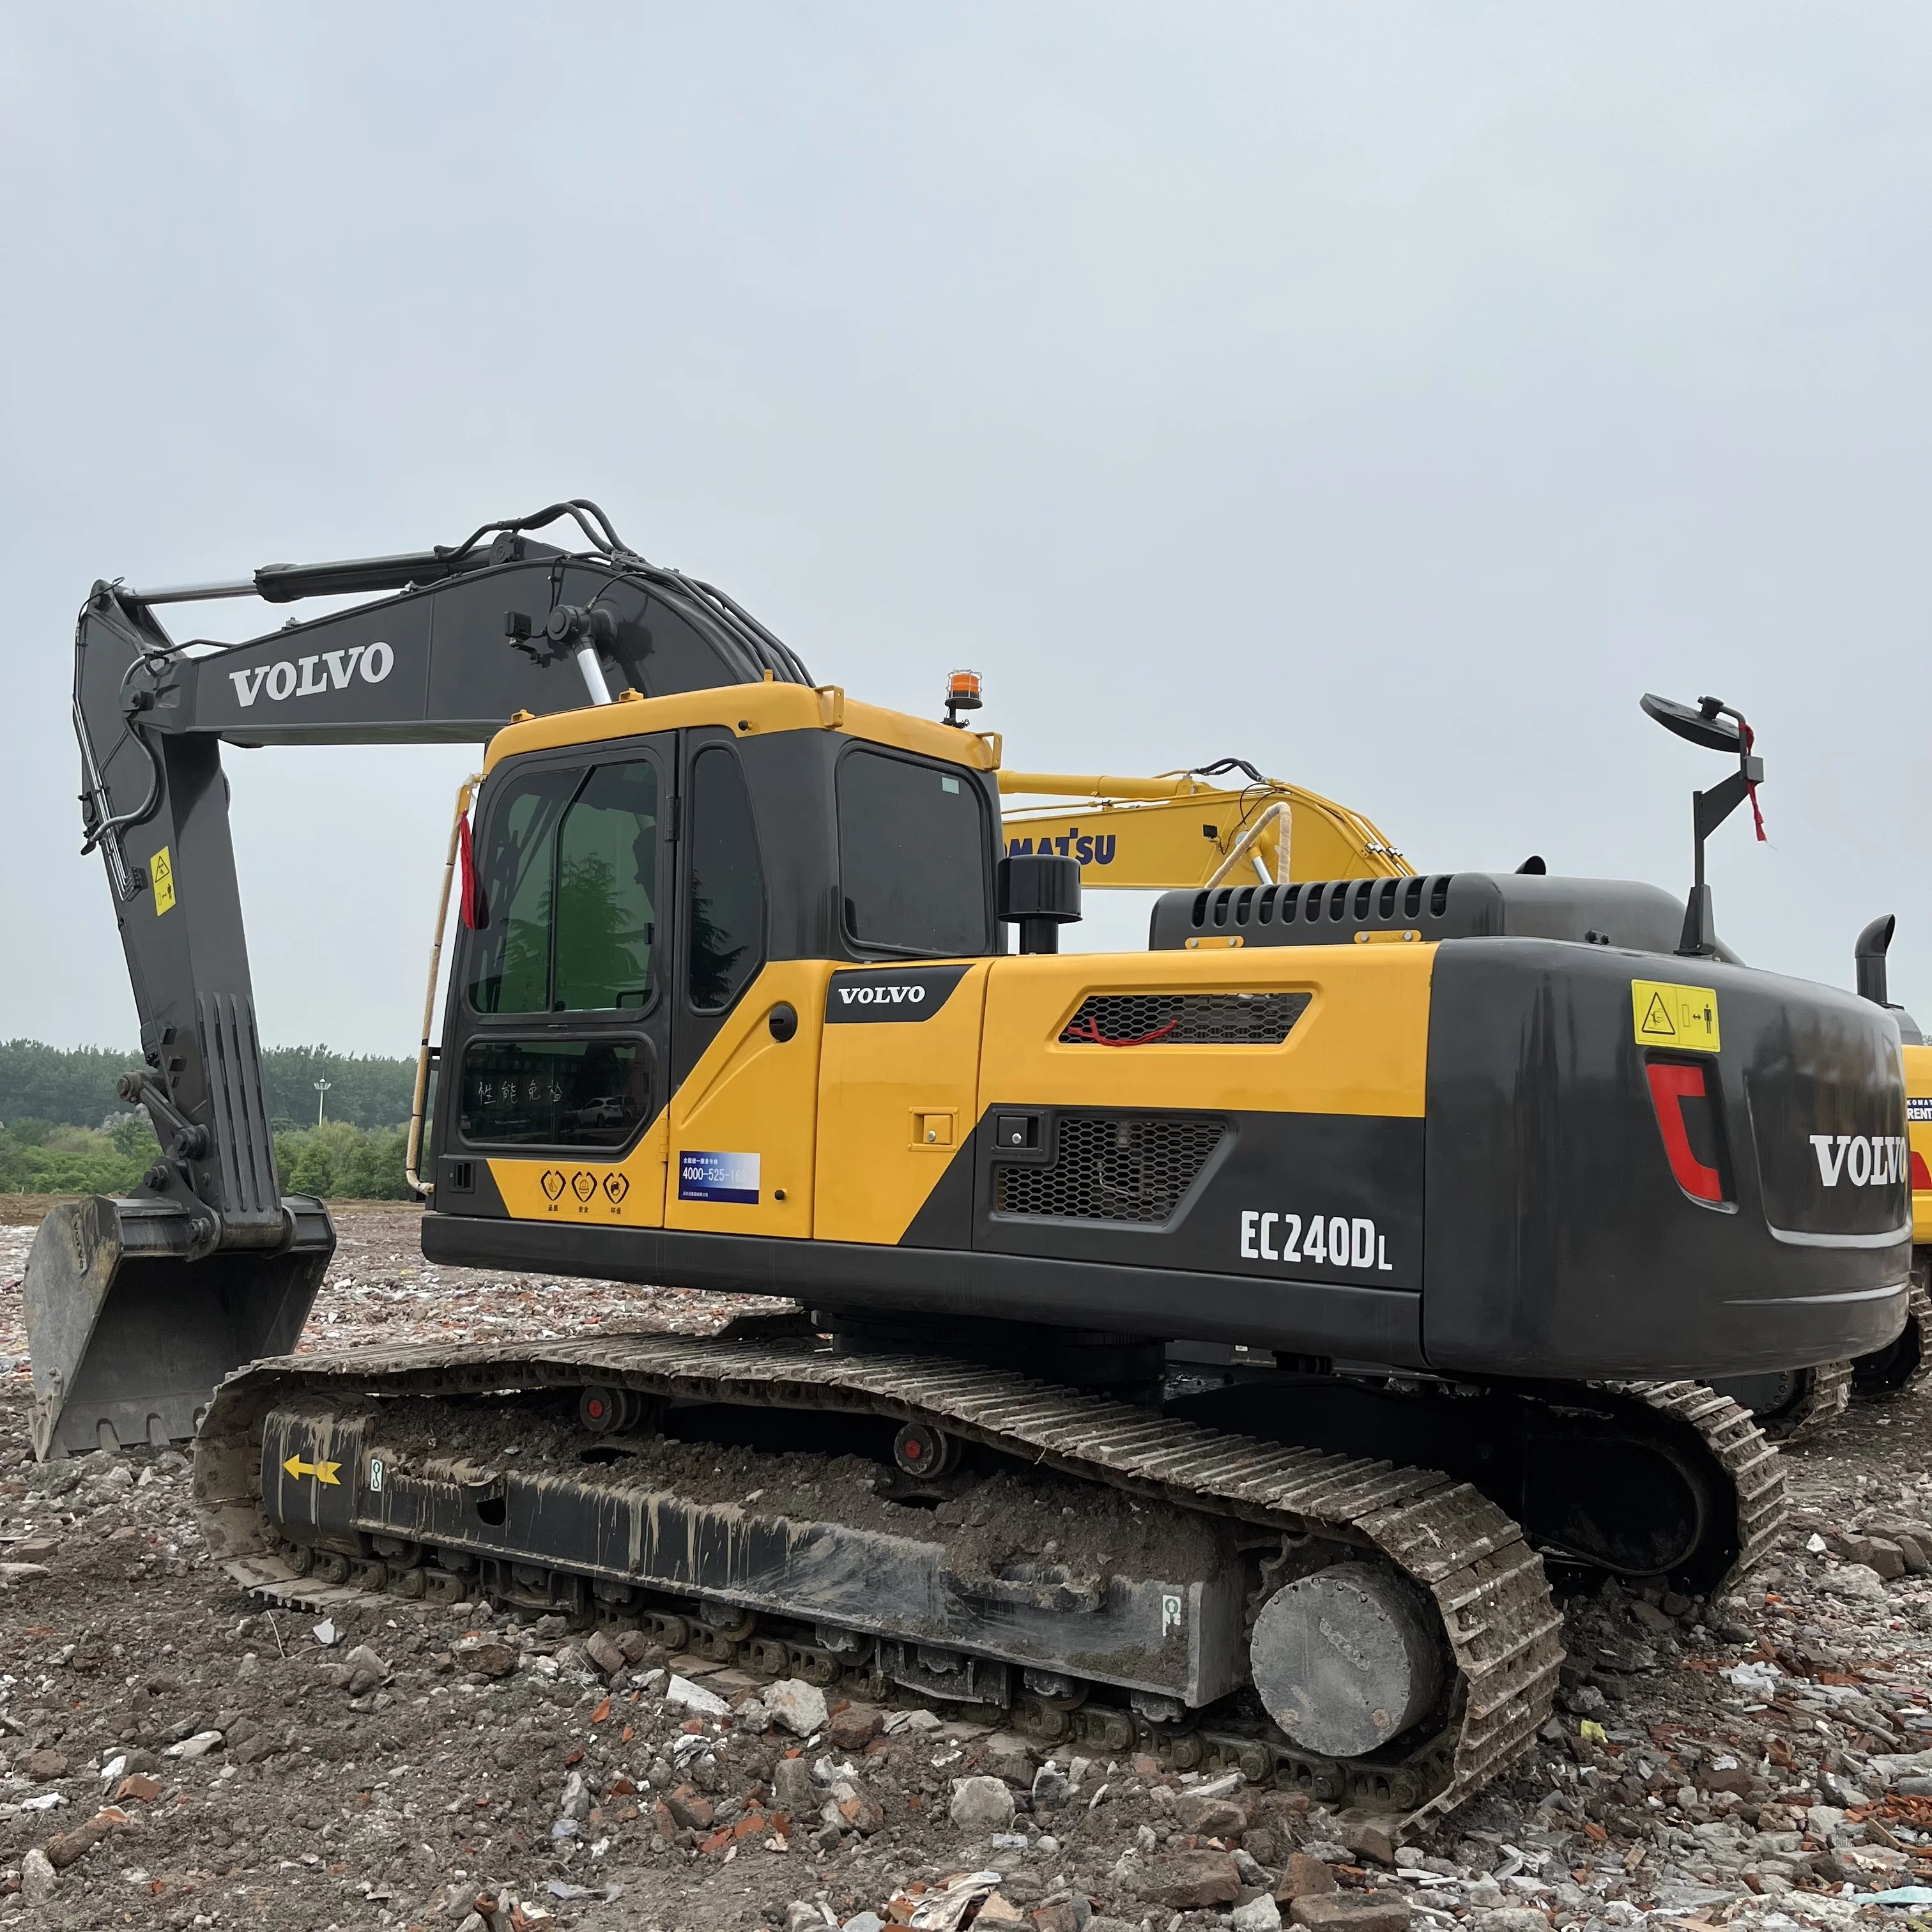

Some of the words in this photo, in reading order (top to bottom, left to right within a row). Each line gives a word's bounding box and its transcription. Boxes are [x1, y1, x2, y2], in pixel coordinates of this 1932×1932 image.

[229, 641, 394, 707] VOLVO
[838, 985, 926, 1004] VOLVO
[1809, 1135, 1908, 1186] VOLVO
